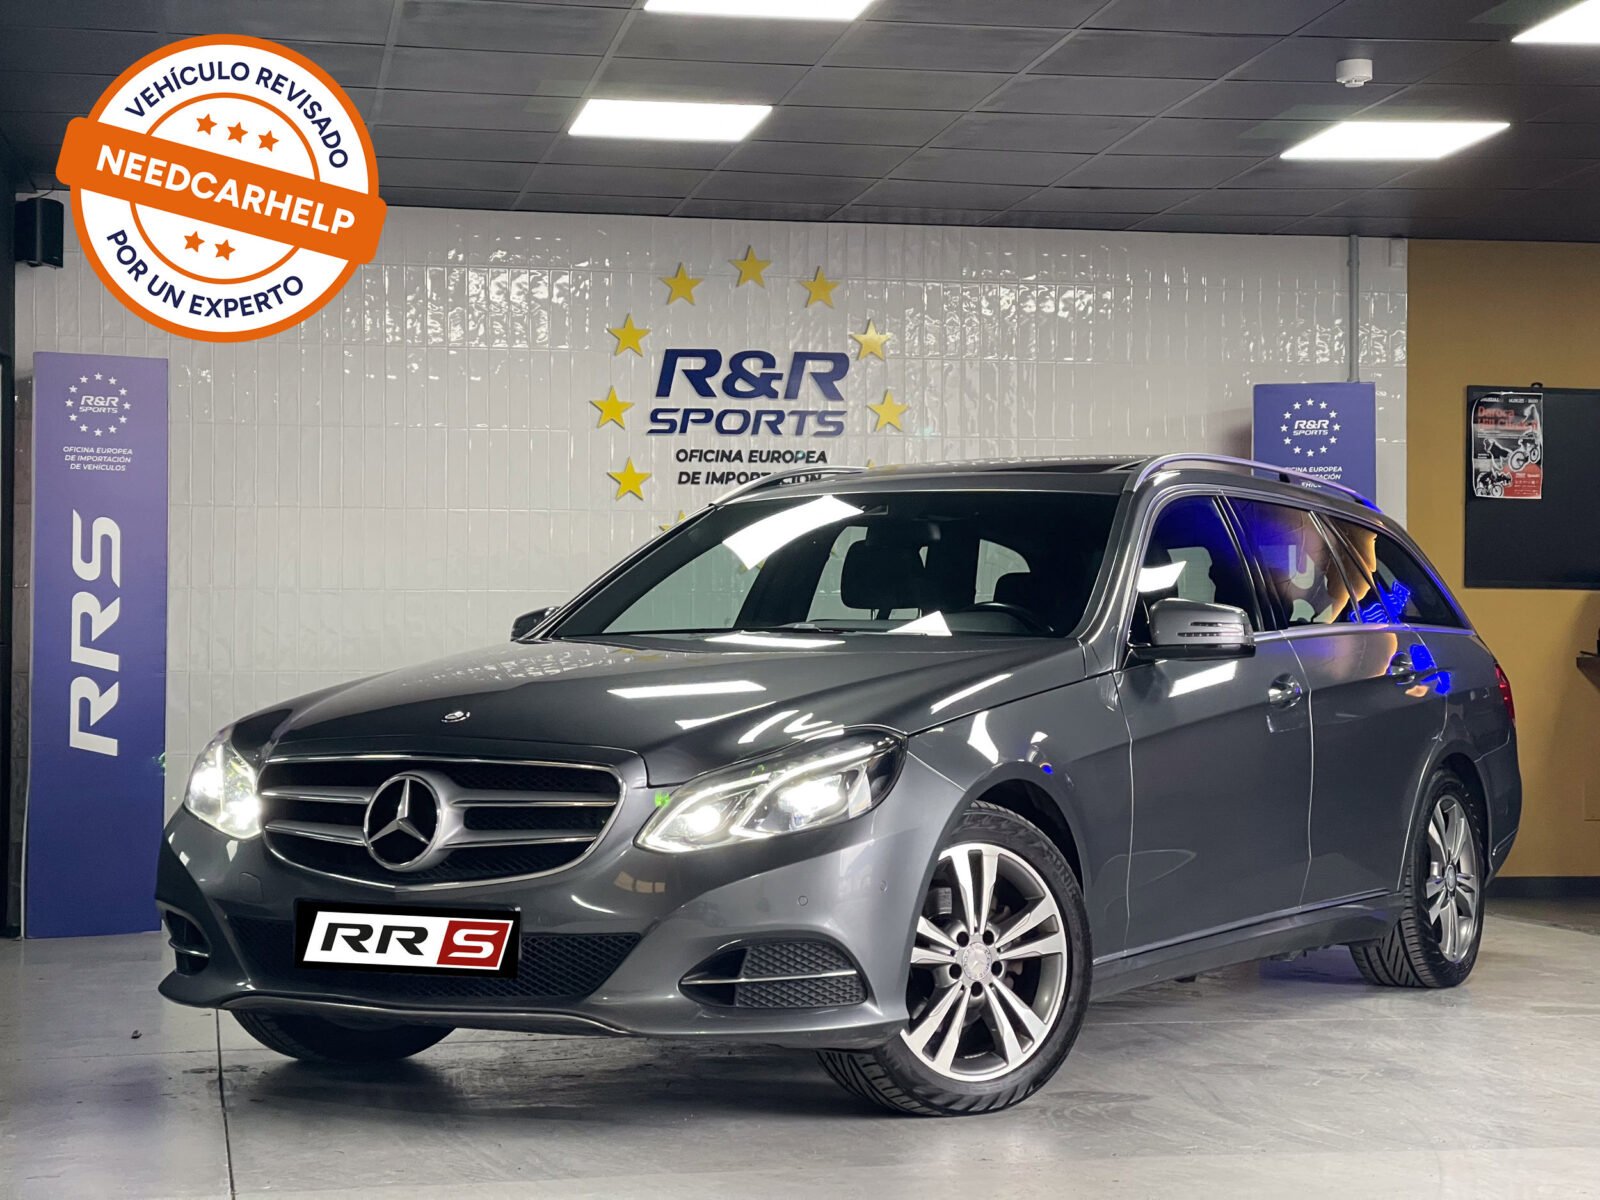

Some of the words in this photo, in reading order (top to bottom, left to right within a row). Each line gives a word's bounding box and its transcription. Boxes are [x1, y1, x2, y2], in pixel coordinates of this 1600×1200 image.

[655, 348, 850, 401] R&R
[80, 395, 119, 407] R&R
[647, 408, 847, 437] SPORTS
[1294, 419, 1329, 430] R&R
[96, 447, 133, 455] EUROPEA
[675, 448, 744, 464] OFICINA
[747, 449, 828, 465] EUROPEA
[77, 455, 131, 463] IMPORTACIÓN
[83, 462, 126, 471] VEHÍCULOS
[677, 471, 702, 485] DE
[69, 508, 121, 757] RRS
